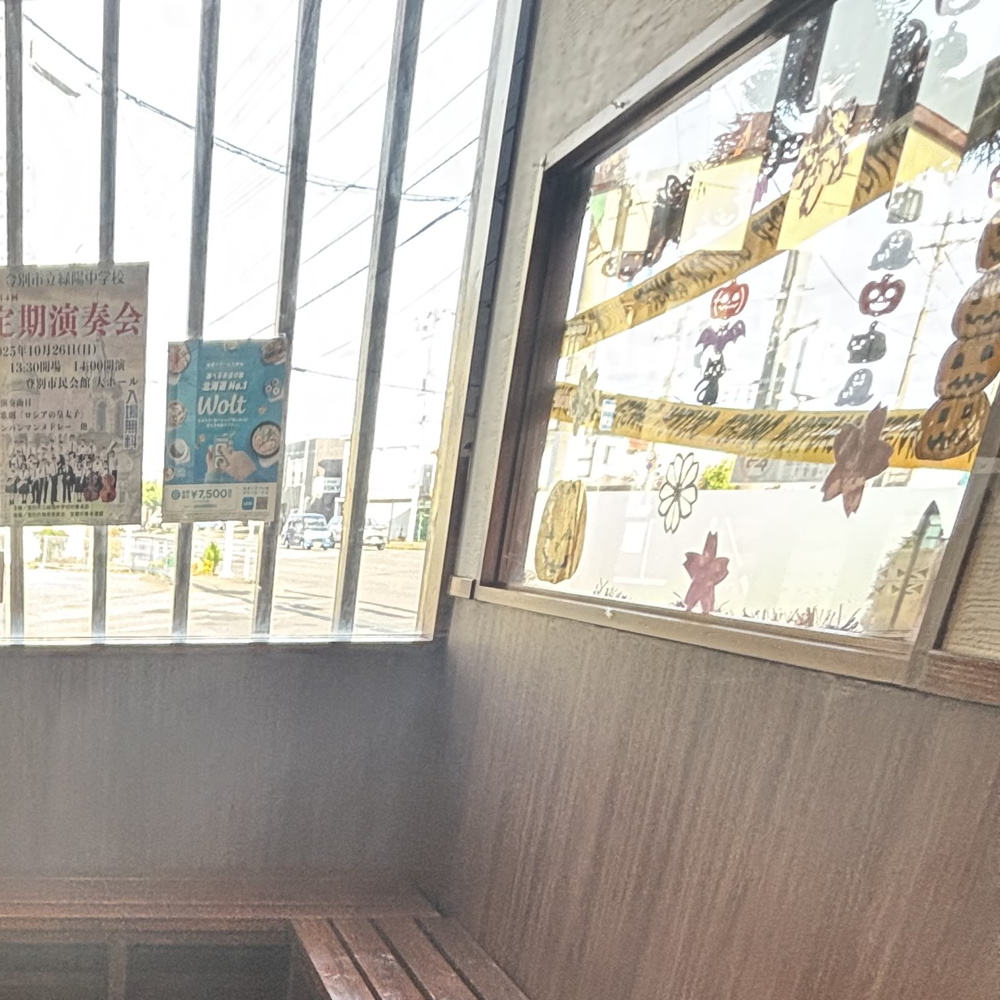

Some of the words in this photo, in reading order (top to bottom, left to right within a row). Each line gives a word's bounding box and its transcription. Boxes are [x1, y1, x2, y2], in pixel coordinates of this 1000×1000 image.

[11, 360, 61, 373] 13:30開場
[26, 376, 90, 389] 登別市民会館
[96, 376, 138, 389] 大ホール
[197, 393, 248, 415] Wolt
[125, 389, 138, 449] 入場無料
[191, 488, 228, 499] ¥7,500
